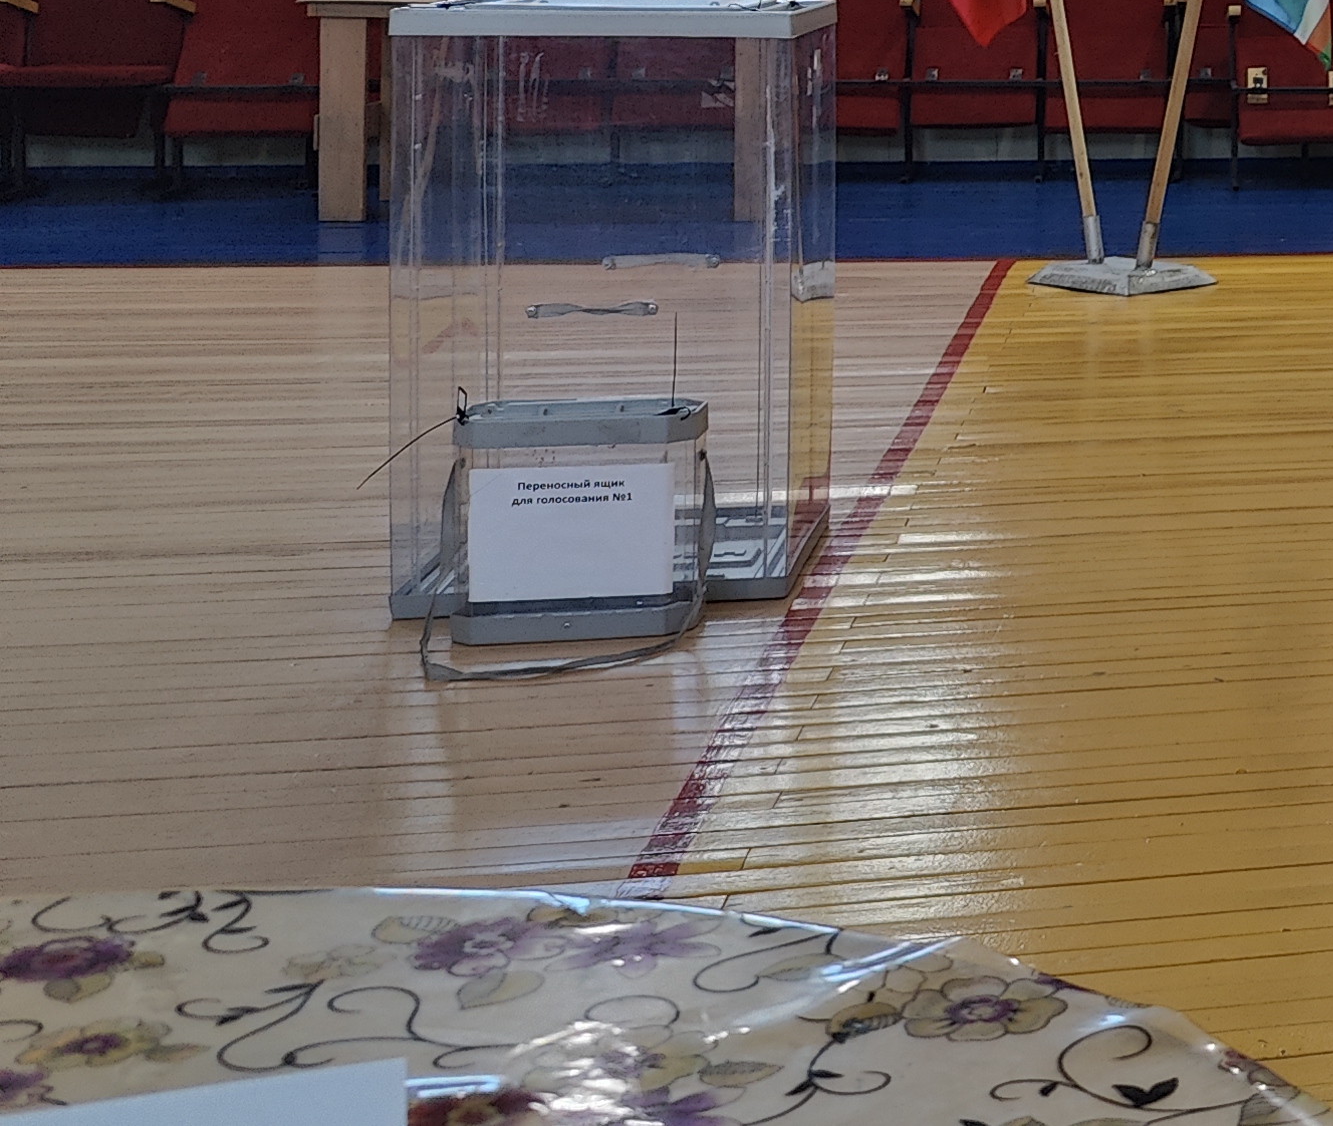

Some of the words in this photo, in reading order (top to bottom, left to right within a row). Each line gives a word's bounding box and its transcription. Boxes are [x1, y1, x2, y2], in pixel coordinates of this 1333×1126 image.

[517, 479, 591, 492] Переносный
[593, 480, 625, 489] ящик
[511, 497, 533, 507] для
[536, 494, 609, 505] голосования
[612, 493, 633, 502] №1
